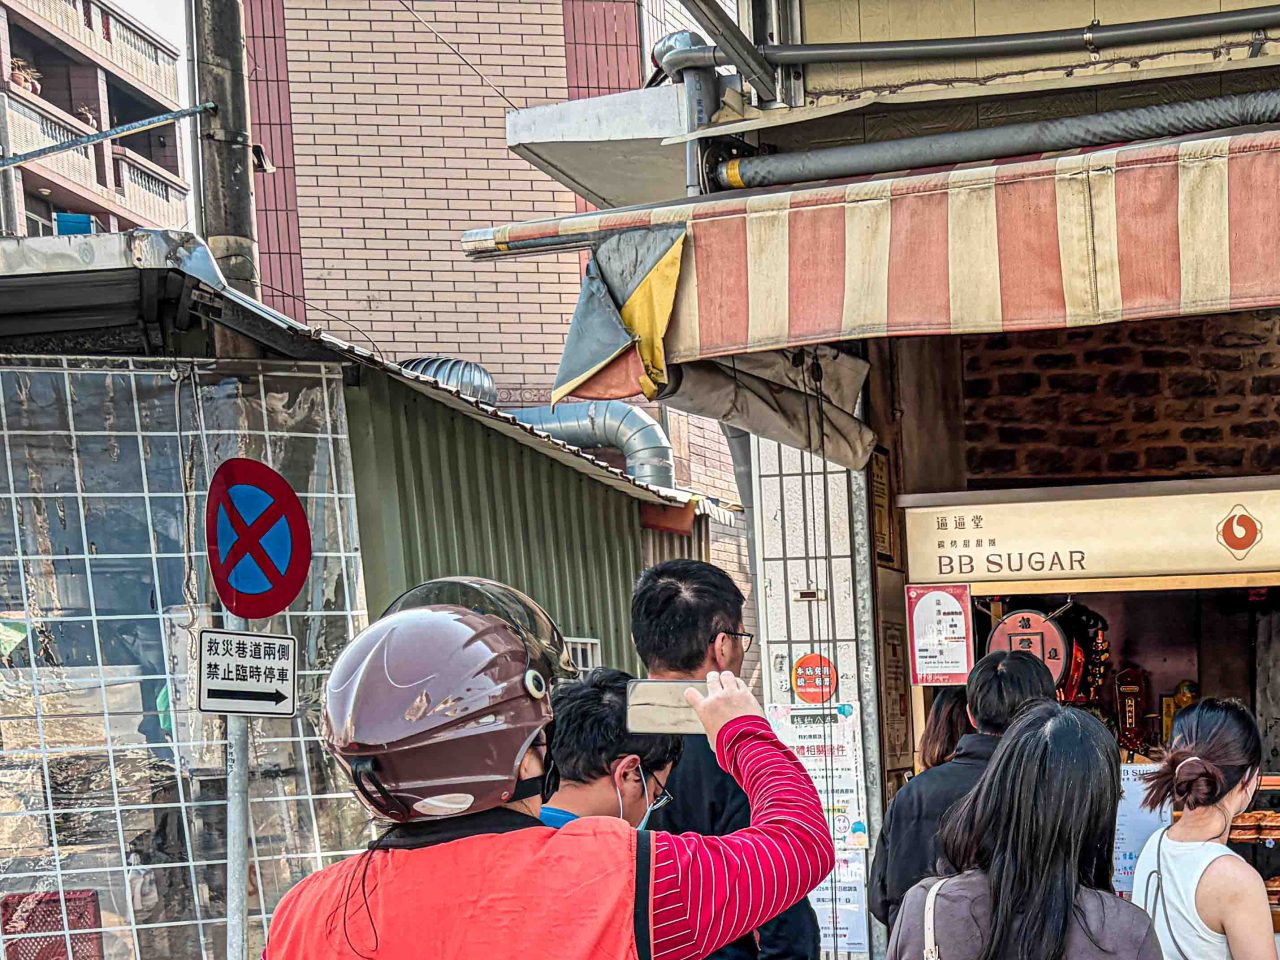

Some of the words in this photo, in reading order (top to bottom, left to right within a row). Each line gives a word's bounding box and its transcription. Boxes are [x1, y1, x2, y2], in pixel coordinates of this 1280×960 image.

[936, 515, 983, 530] 逼逼堂
[938, 554, 975, 575] BB
[986, 550, 1086, 573] SUGAR
[207, 638, 290, 661] 救災巷道兩側
[206, 662, 289, 684] 禁止臨時停車
